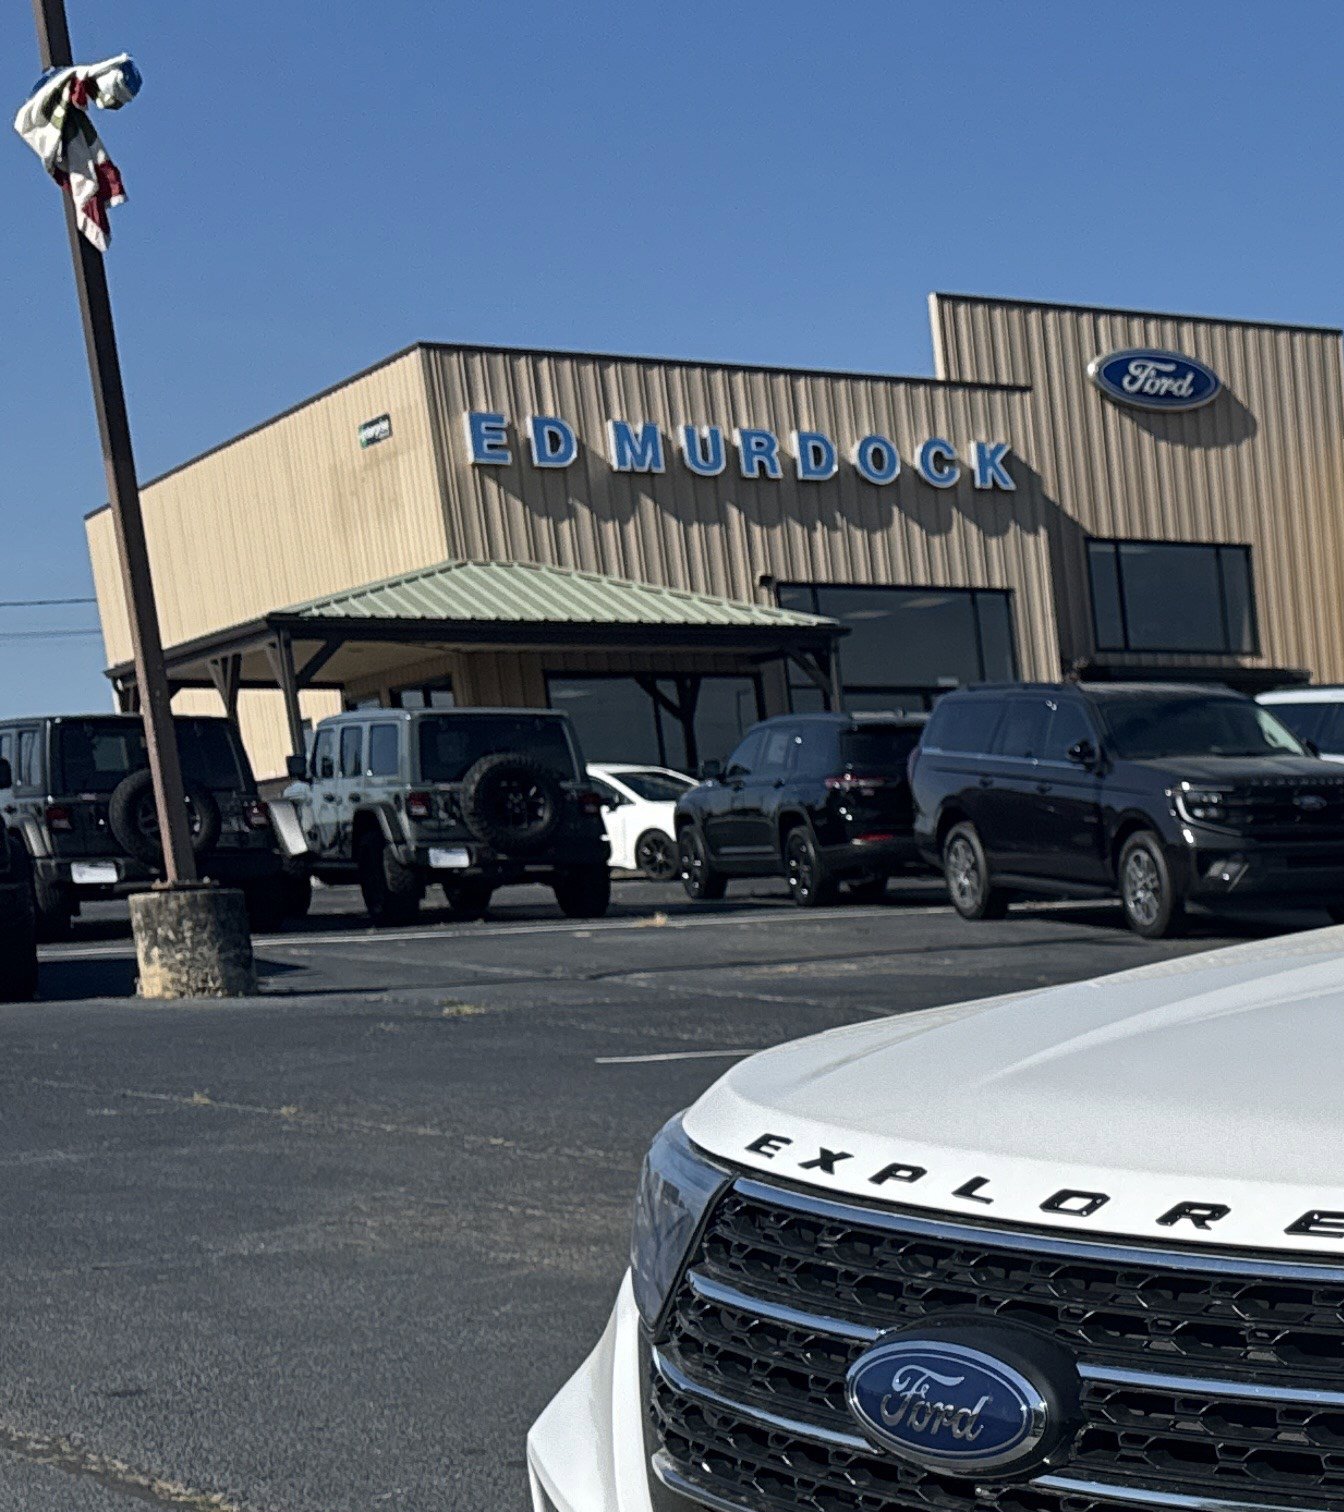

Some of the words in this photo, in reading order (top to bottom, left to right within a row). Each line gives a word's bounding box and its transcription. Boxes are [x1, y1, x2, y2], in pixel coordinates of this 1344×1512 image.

[1122, 359, 1195, 397] Ford
[463, 411, 578, 468] ED
[606, 418, 1017, 491] MURDOCK
[880, 1365, 993, 1441] Ford
